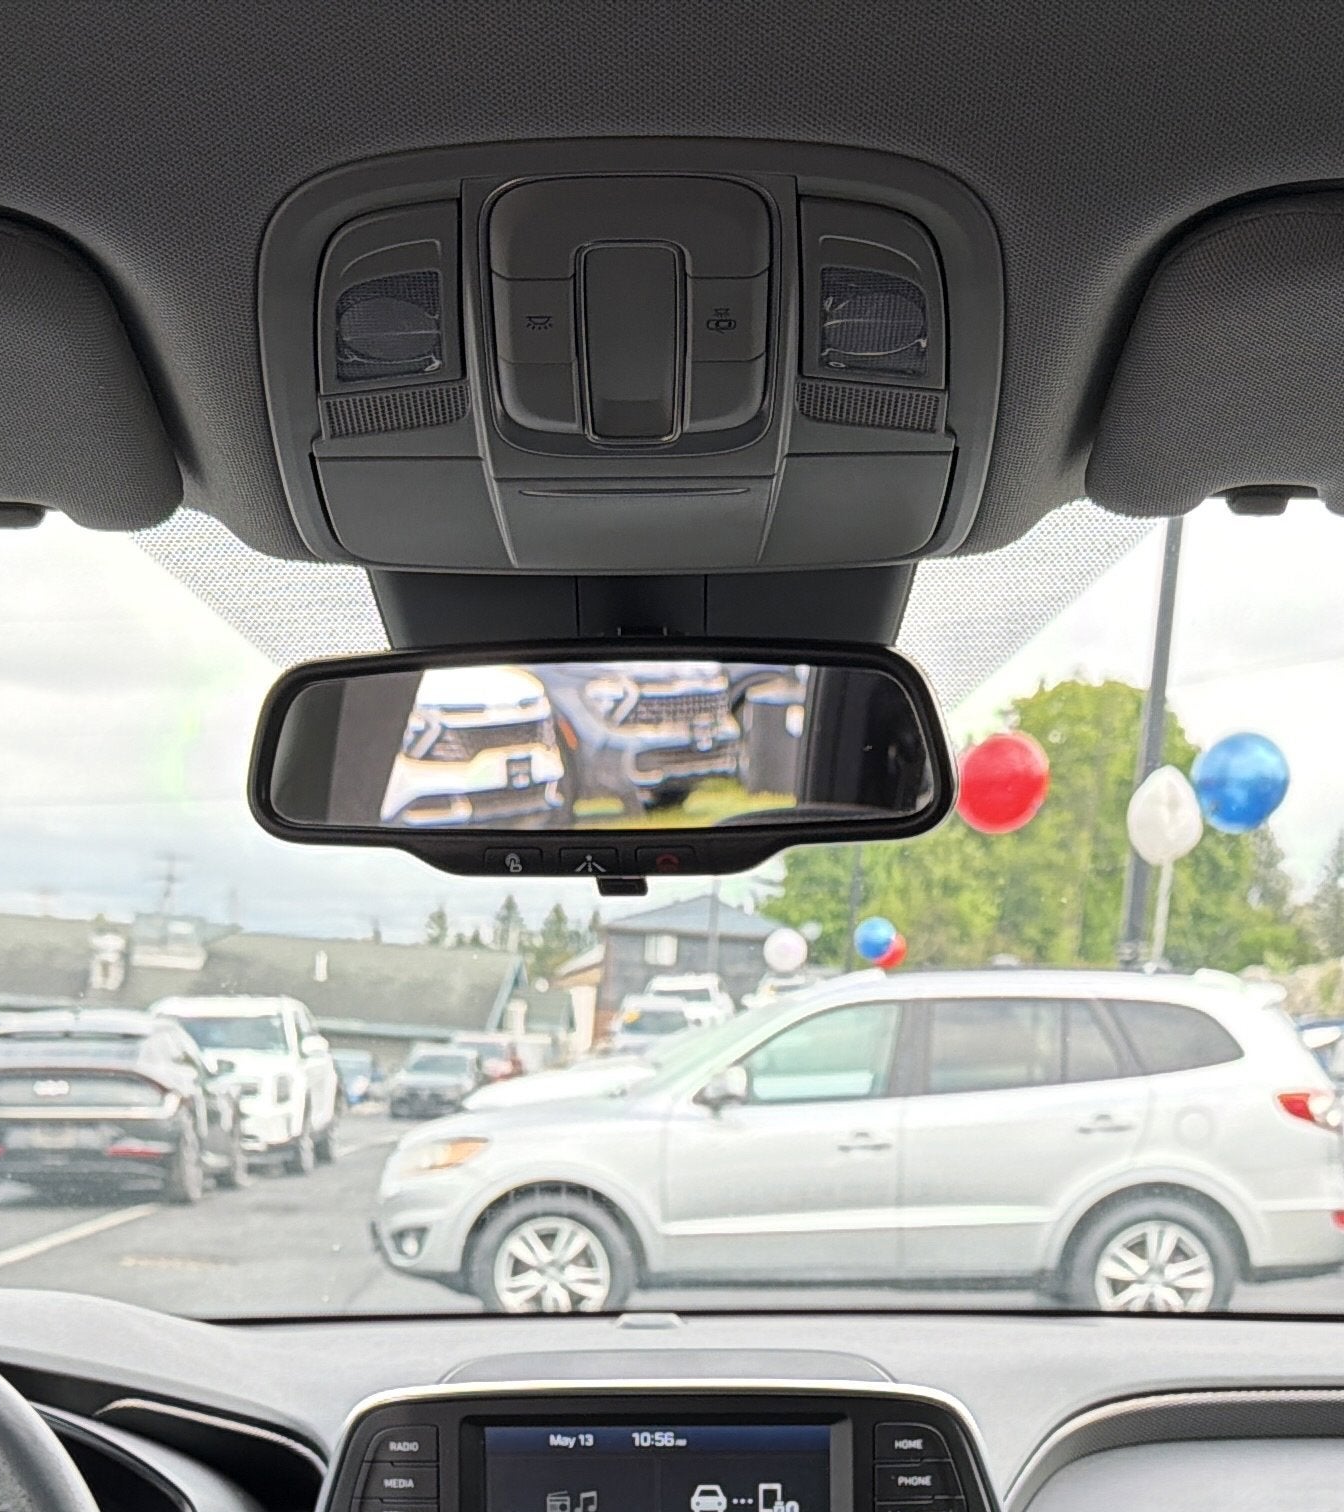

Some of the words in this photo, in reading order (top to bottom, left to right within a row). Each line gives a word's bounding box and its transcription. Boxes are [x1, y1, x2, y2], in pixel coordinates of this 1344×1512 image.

[549, 1434, 576, 1449] May
[578, 1434, 594, 1447] 13
[632, 1431, 675, 1447] 10:56
[894, 1439, 923, 1450] HOME
[389, 1441, 419, 1452] RADIO
[383, 1479, 414, 1489] MEDIA
[897, 1476, 932, 1486] PHONE
